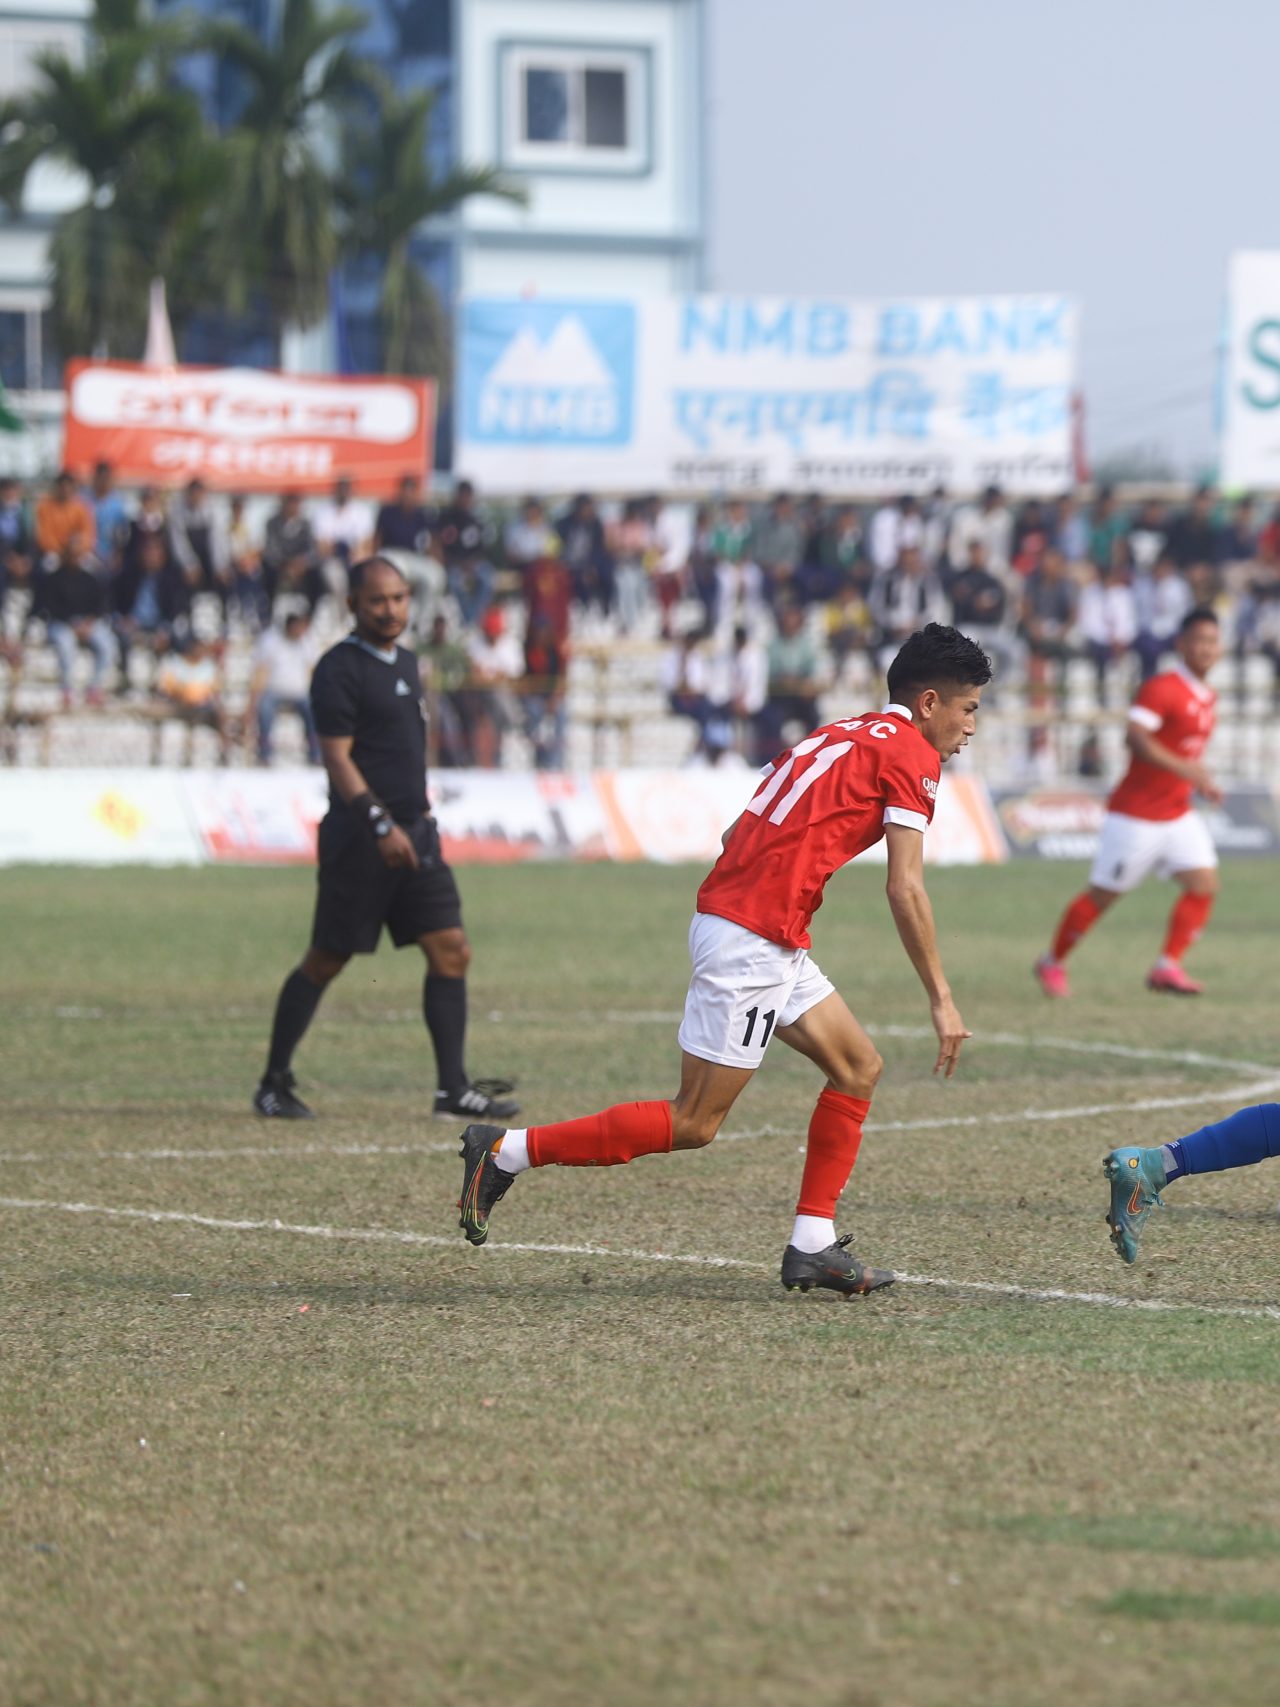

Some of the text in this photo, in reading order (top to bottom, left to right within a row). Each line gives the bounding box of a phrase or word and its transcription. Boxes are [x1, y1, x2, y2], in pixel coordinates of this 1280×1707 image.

[678, 297, 1072, 355] NMB BANK
[477, 383, 620, 437] NMB
[745, 732, 855, 826] 11
[922, 777, 937, 794] QAT
[742, 1006, 776, 1048] 11
